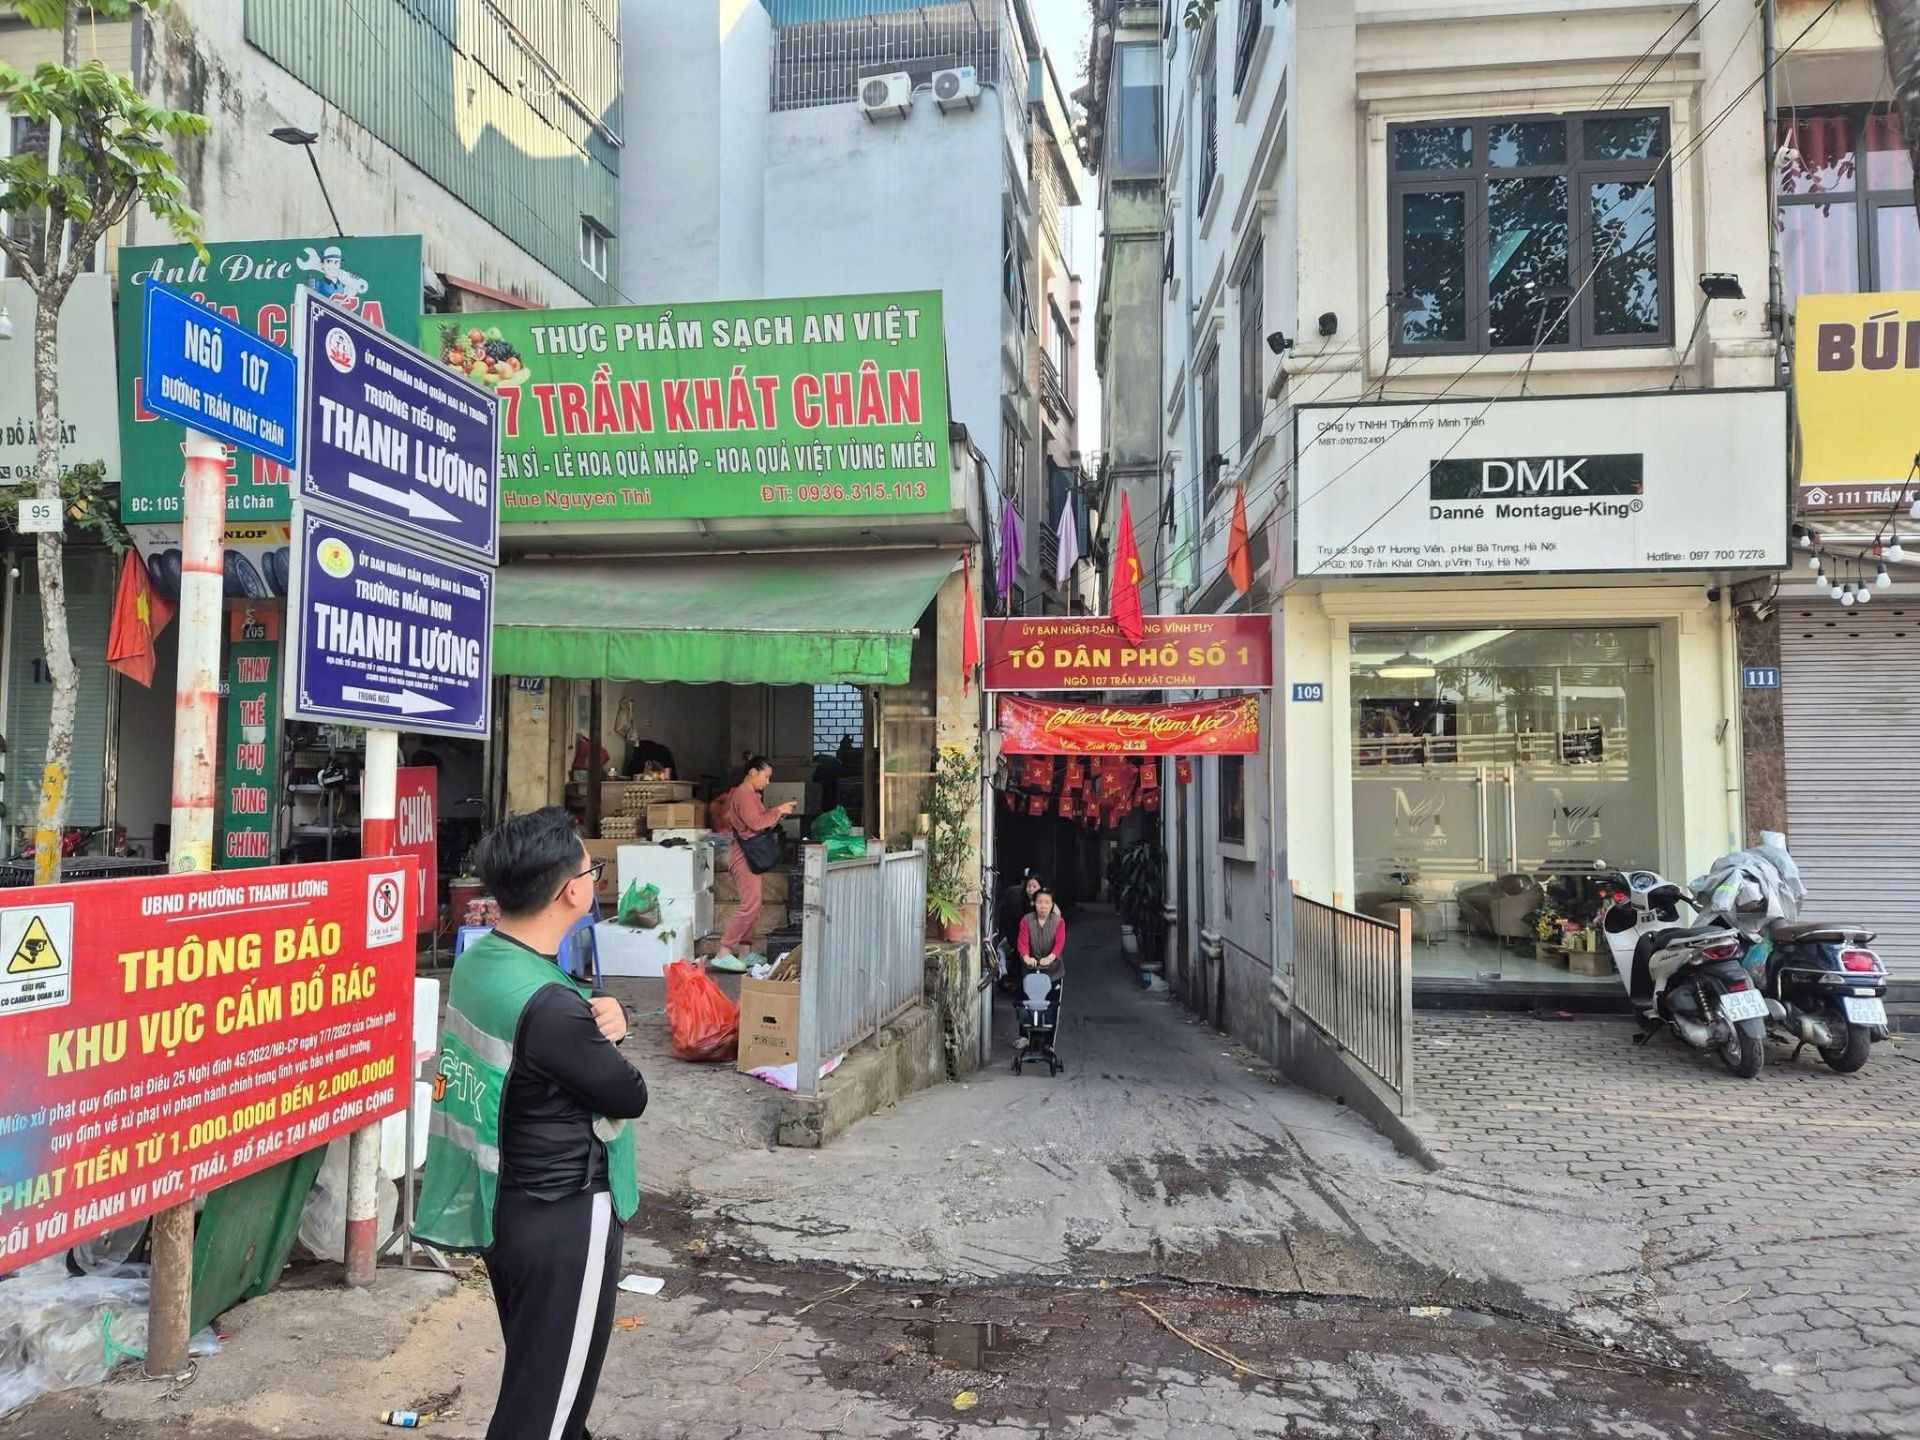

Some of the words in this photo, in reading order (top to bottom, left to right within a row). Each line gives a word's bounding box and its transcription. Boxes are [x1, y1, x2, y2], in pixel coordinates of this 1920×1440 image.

[131, 256, 209, 285] Anh
[220, 254, 292, 281] Đức
[531, 321, 608, 359] THỰC
[614, 309, 704, 351] PHẨM
[712, 315, 795, 353] SẠCH
[802, 312, 845, 344] AN
[852, 303, 921, 347] VIỆT
[185, 320, 223, 373] NGÕ
[240, 350, 269, 396] 107
[161, 375, 200, 411] ĐƯỜNG
[233, 408, 258, 435] KHÁT
[259, 418, 284, 447] CHÂN
[364, 383, 409, 420] TRƯỜNG
[411, 405, 433, 432] TIỂU
[435, 417, 457, 443] HỌC
[531, 363, 655, 436] TRẦN
[661, 364, 781, 433] KHÁT
[792, 359, 923, 430] CHÂN
[7, 417, 24, 445] ĐỒ
[1317, 422, 1344, 433] Công
[1346, 422, 1355, 433] ty
[1358, 420, 1387, 430] TNHH
[1419, 418, 1434, 430] mỹ
[1438, 418, 1460, 428] Minh
[319, 395, 408, 475] THANH
[415, 439, 488, 507] LƯƠNG
[522, 445, 540, 478] SỈ
[553, 445, 576, 478] LẺ
[577, 450, 613, 478] HOA
[615, 443, 651, 479] QUẢ
[654, 443, 699, 480] NHẬP
[715, 447, 752, 474] HOA
[755, 439, 791, 475] QUẢ
[794, 439, 833, 477] VIỆT
[837, 438, 886, 470] VÙNG
[891, 432, 936, 469] MIỀN
[1482, 458, 1589, 493] DMK
[132, 498, 153, 511] ĐC:
[158, 497, 179, 511] 105
[243, 495, 274, 509] Chân
[504, 491, 540, 507] Hue
[544, 490, 616, 509] Nguyen
[620, 488, 652, 504] Thi
[761, 485, 793, 502] ĐT:
[798, 483, 927, 501] 0936.315.113
[1837, 491, 1860, 504] 111
[32, 506, 50, 518] 95
[1430, 504, 1484, 520] Danné
[1647, 551, 1685, 562] Hotline:
[1689, 550, 1709, 561] 097
[1714, 550, 1735, 560] 700
[1738, 549, 1765, 559] 7273
[355, 579, 399, 609] TRƯỜNG
[430, 599, 452, 621] NON
[314, 602, 402, 664] THANH
[408, 625, 480, 679] LƯƠNG
[1022, 626, 1036, 636] ỦY
[1037, 625, 1056, 635] BAN
[1060, 624, 1090, 635] NHÂN
[1092, 624, 1114, 634] DÂN
[1164, 622, 1191, 633] VĨNH
[237, 656, 270, 683] THAY
[1008, 640, 1045, 669] TỔ
[1054, 644, 1110, 668] DÂN
[1120, 640, 1179, 667] PHỐ
[1188, 639, 1227, 666] SỐ
[1237, 646, 1249, 665] 1
[1064, 674, 1088, 686] NGÕ
[1092, 676, 1107, 685] 107
[1138, 673, 1163, 685] KHÁT
[1166, 673, 1196, 685] CHÂN
[1296, 686, 1321, 699] 109
[1748, 671, 1776, 687] 111
[240, 692, 266, 726] THẾ
[237, 743, 265, 775] PHỤ
[232, 783, 267, 814] TÙNG
[401, 785, 434, 846] CHỮA
[226, 826, 271, 858] CHÍNH
[142, 893, 184, 917] UBND
[188, 885, 245, 911] PHƯỜNG
[249, 883, 289, 904] THANH
[292, 880, 328, 898] LƯƠNG
[118, 933, 262, 994] THÔNG
[274, 917, 341, 965] BÁO
[47, 1019, 128, 1077] KHU
[139, 1002, 205, 1057] VỰC
[215, 977, 282, 1035] CẤM
[290, 963, 326, 1017] ĐỔ
[331, 962, 376, 1006] RÁC
[0, 1116, 28, 1136] Mức
[50, 1102, 75, 1126] phạt
[79, 1096, 100, 1116] quy
[103, 1087, 127, 1109] định
[130, 1083, 144, 1100] tại
[147, 1073, 170, 1095] Điều
[173, 1071, 185, 1086] 25
[188, 1062, 210, 1083] Nghị
[212, 1056, 232, 1077] định
[234, 1038, 299, 1067] 45/2022/NĐ-CP
[299, 1032, 318, 1052] ngày
[320, 1022, 351, 1043] 7/7/2022
[351, 1019, 365, 1034] của
[365, 1014, 383, 1030] Chính
[384, 1011, 396, 1026] phủ
[51, 1131, 73, 1155] quy
[77, 1122, 101, 1145] định
[104, 1113, 118, 1132] về
[121, 1109, 135, 1130] xử
[137, 1106, 160, 1128] phạt
[162, 1099, 172, 1117] vi
[174, 1094, 202, 1115] phạm
[204, 1080, 227, 1099] hành
[229, 1072, 253, 1095] chính
[255, 1067, 277, 1086] trong
[294, 1057, 308, 1074] vực
[310, 1052, 323, 1070] bảo
[325, 1049, 334, 1064] vệ
[335, 1044, 349, 1061] môi
[0, 1167, 67, 1215] PHẠT
[74, 1144, 128, 1190] TIỀN
[135, 1132, 165, 1168] TỪ
[169, 1096, 276, 1156] 1.000.000đ
[280, 1080, 314, 1116] ĐẾN
[318, 1055, 395, 1101] 2.000.000đ
[35, 1212, 68, 1244] VỚI
[73, 1192, 125, 1230] HÀNH
[130, 1184, 146, 1207] VI
[152, 1170, 184, 1200] VỨT,
[190, 1151, 228, 1184] THẢI,
[233, 1137, 254, 1168] ĐỔ
[257, 1129, 283, 1162] RÁC
[287, 1123, 305, 1144] TẠI
[308, 1114, 330, 1136] NƠI
[333, 1098, 363, 1126] CÔNG
[365, 1087, 394, 1114] CỘNG
